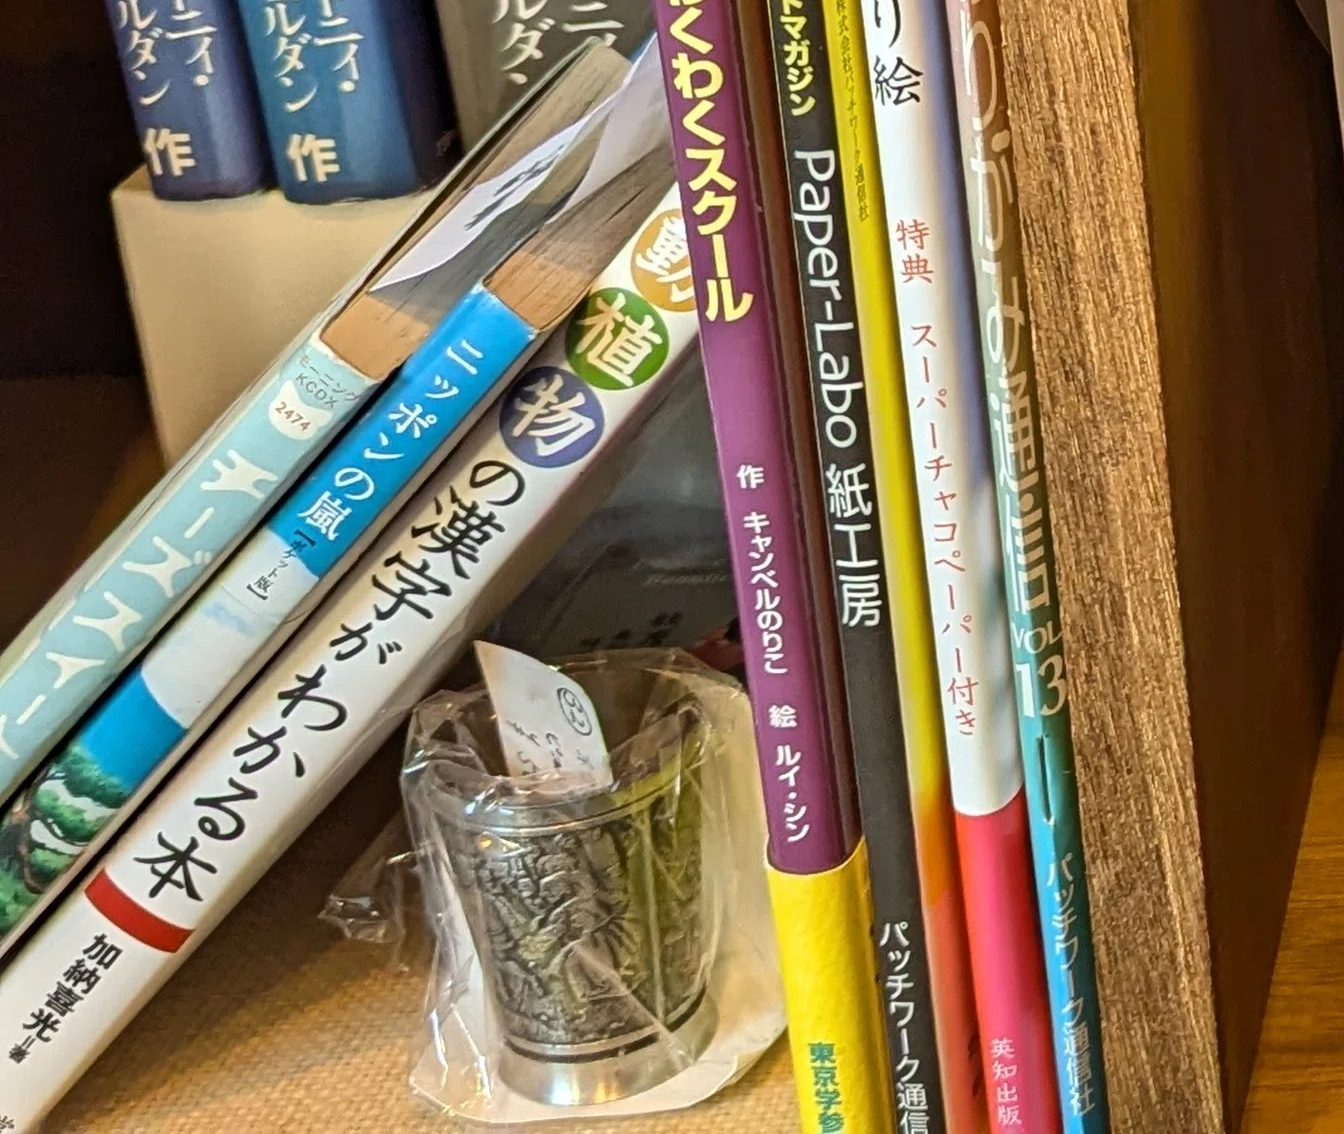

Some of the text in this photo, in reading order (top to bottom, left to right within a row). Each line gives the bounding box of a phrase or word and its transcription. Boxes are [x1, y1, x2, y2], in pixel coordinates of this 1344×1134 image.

[145, 128, 196, 177] 作
[288, 133, 340, 182] 作
[275, 401, 312, 432] 2474
[298, 338, 485, 541] ニッポンの嵐
[795, 149, 882, 627] Paper-Labo 紙工房
[896, 218, 979, 738] 特典 スーパーチャコペーパー付き
[134, 213, 696, 903] 動植物の漢字がわかる本
[736, 465, 808, 843] 作 キャンベルのりこ 絵 ルイ・シン
[1015, 654, 1068, 718] 13
[991, 1038, 1022, 1126] 英知出版
